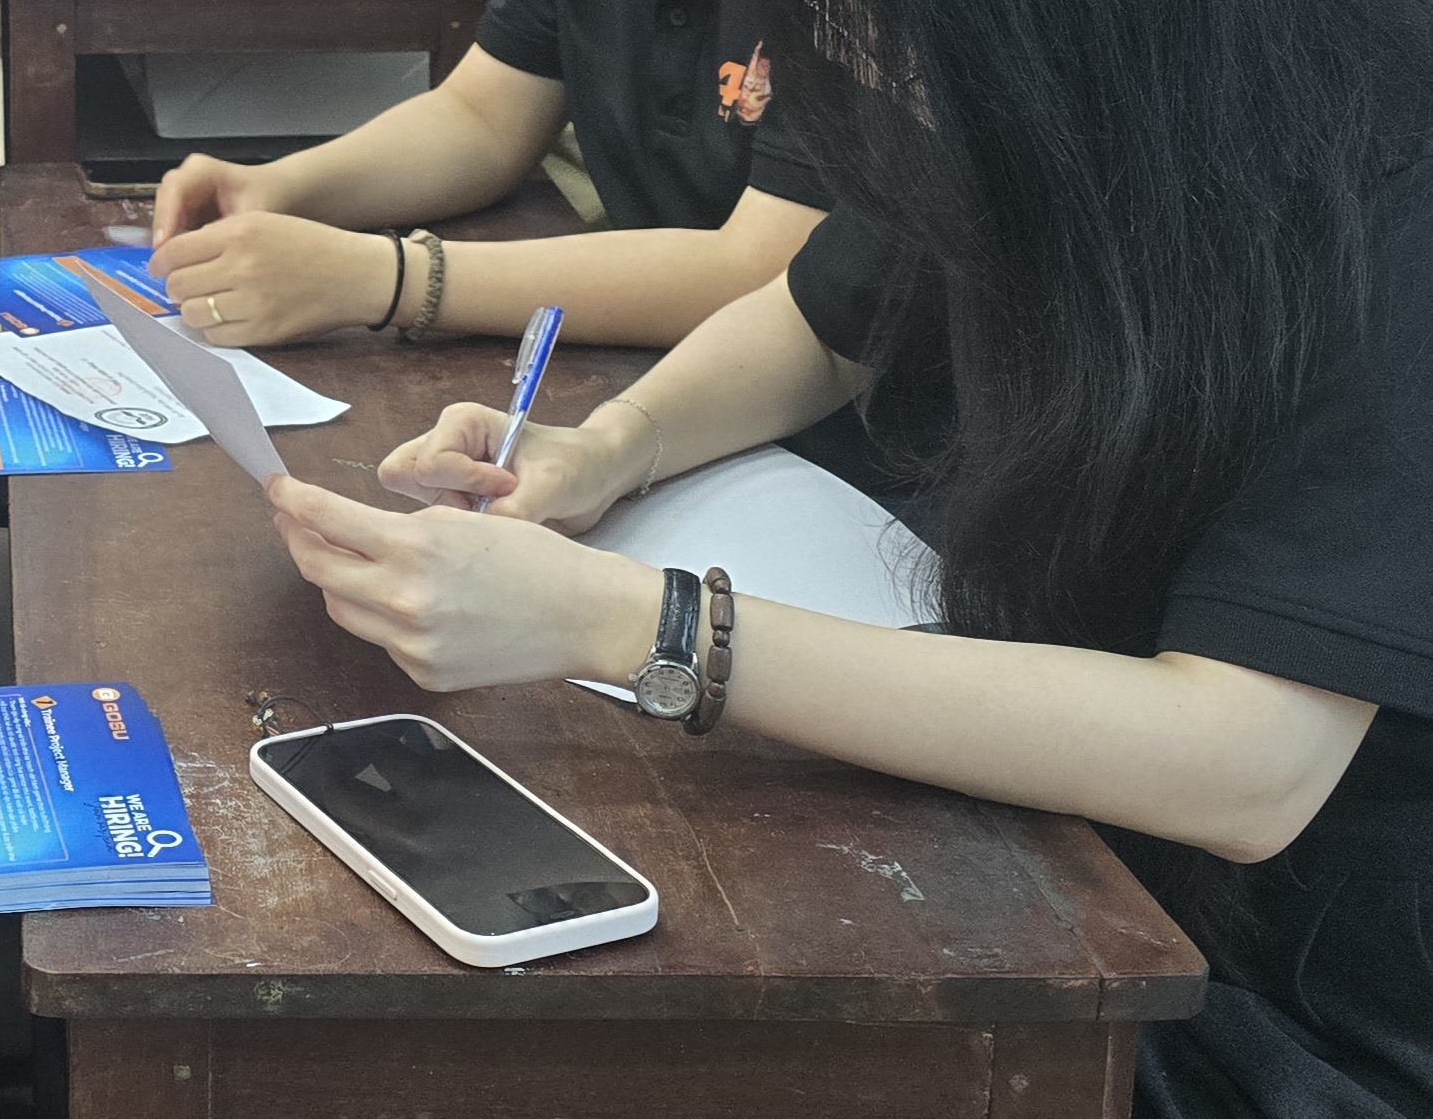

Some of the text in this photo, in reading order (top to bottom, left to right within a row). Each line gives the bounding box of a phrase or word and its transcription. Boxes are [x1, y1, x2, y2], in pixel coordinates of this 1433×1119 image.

[105, 434, 137, 468] HIRING!
[102, 702, 130, 741] GOSU
[48, 734, 66, 760] Project
[56, 759, 75, 792] Manager
[98, 795, 145, 859] HIRING!
[126, 793, 153, 832] WE ARE
